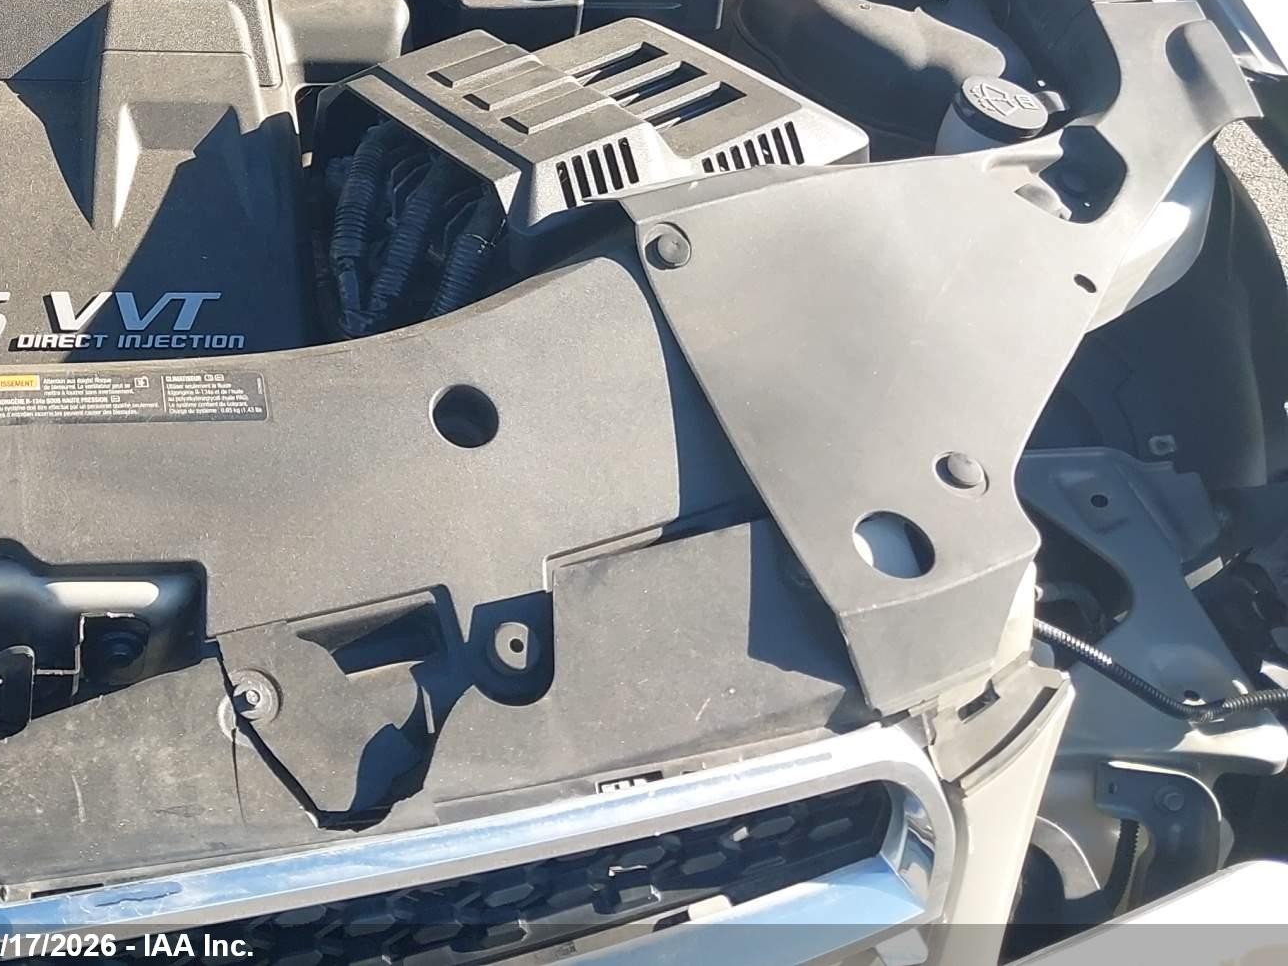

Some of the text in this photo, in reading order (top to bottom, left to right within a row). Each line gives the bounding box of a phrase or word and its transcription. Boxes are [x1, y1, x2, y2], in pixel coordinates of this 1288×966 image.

[44, 291, 221, 332] VVT
[15, 334, 245, 350] DIRECT INJECTION
